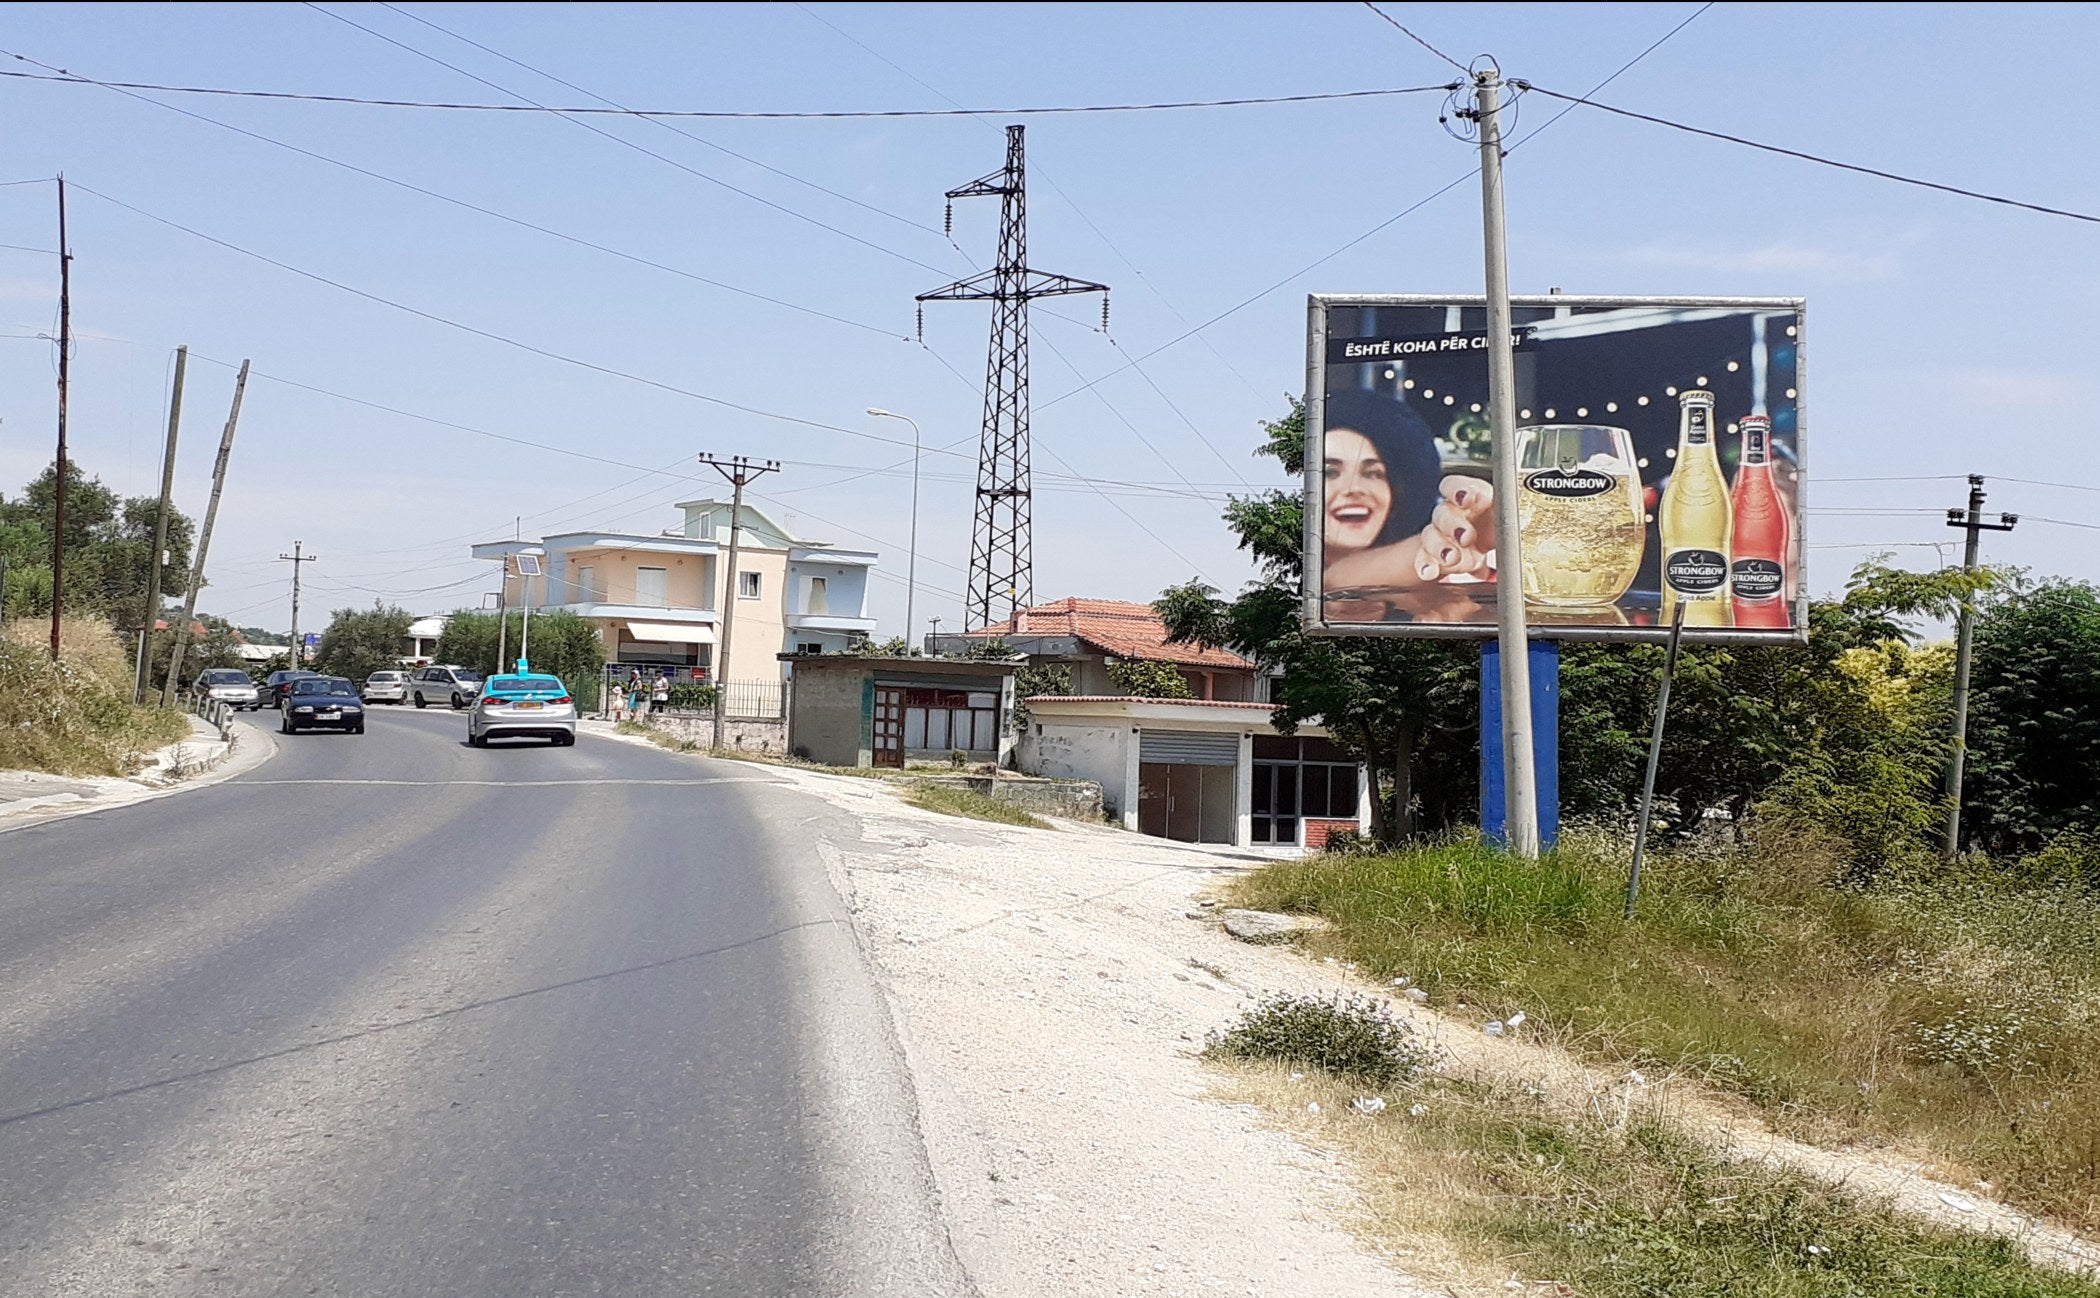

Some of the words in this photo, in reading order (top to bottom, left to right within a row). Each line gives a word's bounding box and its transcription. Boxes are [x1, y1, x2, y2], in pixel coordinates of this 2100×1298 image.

[1344, 340, 1391, 357] ËSHTË
[1393, 340, 1437, 354] KOHA
[1440, 336, 1468, 351] PËR
[1533, 478, 1606, 489] STRONGBOW
[1669, 566, 1724, 575] STRONGBOW
[1731, 574, 1780, 582] STRONGBOW
